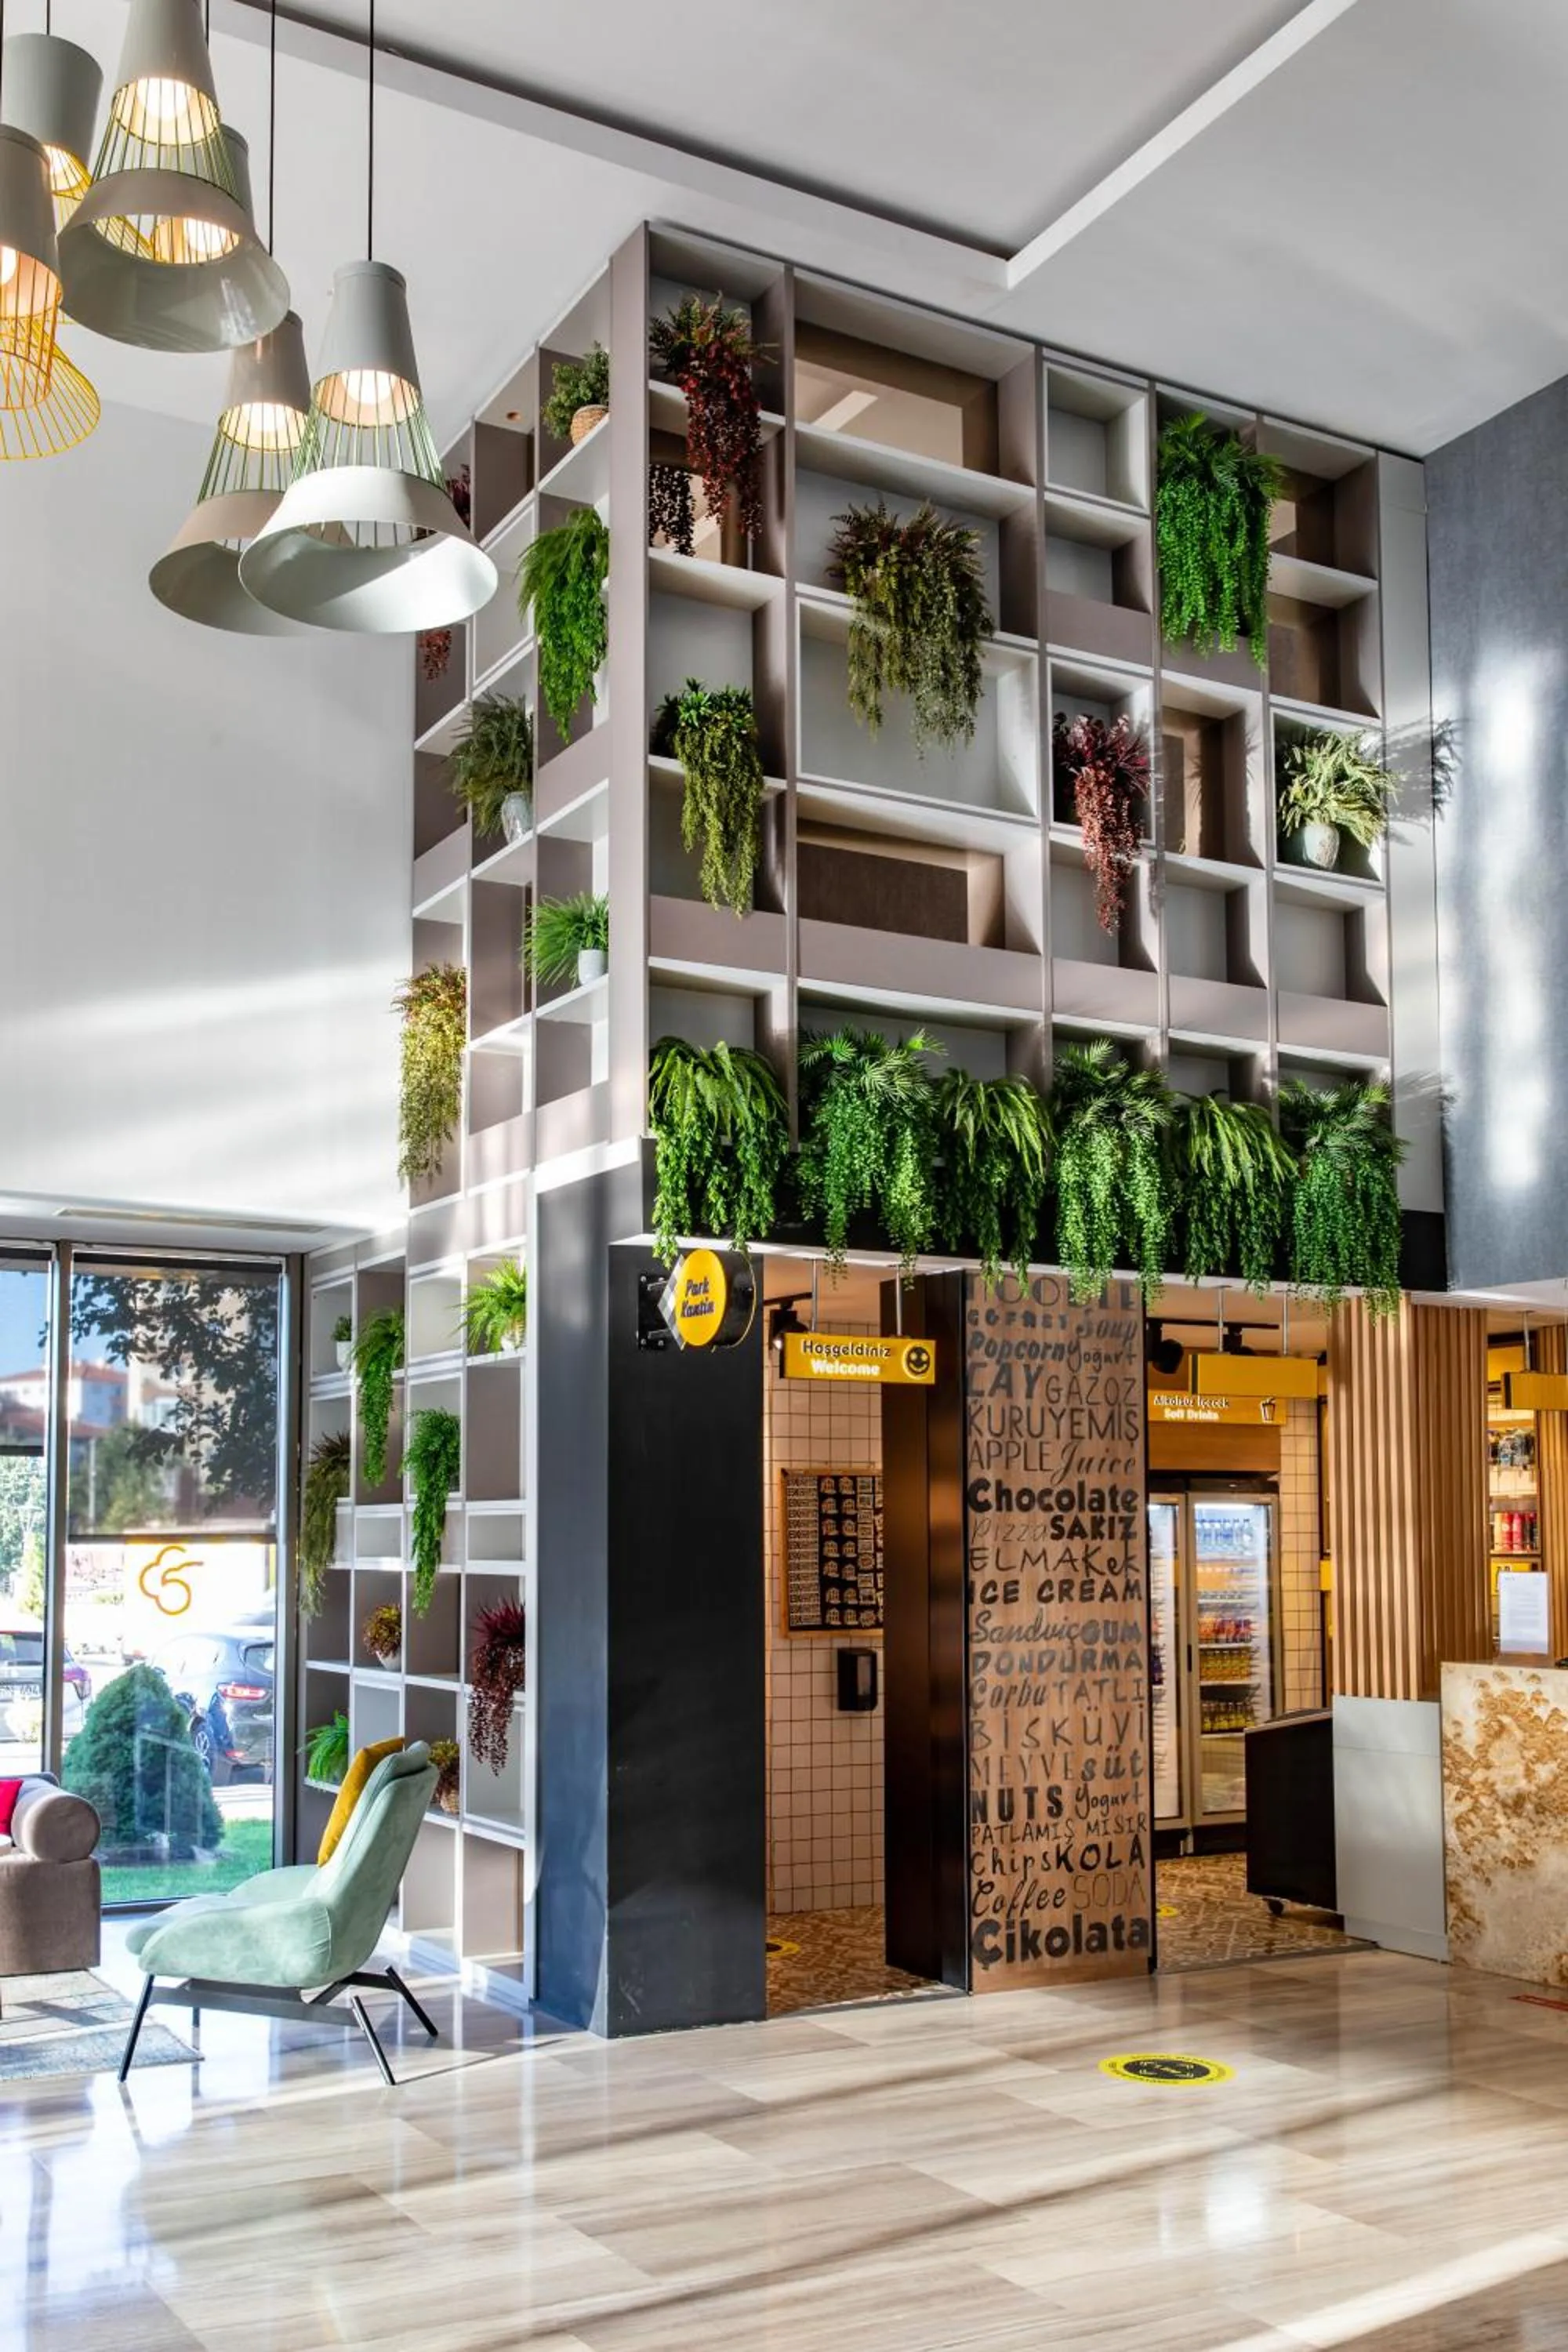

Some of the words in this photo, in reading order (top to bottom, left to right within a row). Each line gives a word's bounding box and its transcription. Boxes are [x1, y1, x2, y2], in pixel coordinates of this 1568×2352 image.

[685, 1276, 710, 1298] Park
[1076, 1308, 1137, 1346] Soup
[801, 1340, 891, 1358] Hoşgeldiniz
[967, 1330, 1067, 1367] Popcorn
[811, 1359, 880, 1376] Welcome
[1045, 1374, 1138, 1406] GAZOZ
[969, 1439, 1054, 1472] APPLE
[1051, 1439, 1137, 1486] Juice
[968, 1478, 1138, 1514] Chocolate
[1049, 1514, 1136, 1541] SAKIZ
[969, 1579, 1020, 1605] ICE
[1037, 1578, 1142, 1604] CREAM
[970, 1610, 1082, 1648] Sandviç
[971, 1647, 1144, 1676] DONDURMA
[1053, 1677, 1145, 1706] TATLI
[971, 1703, 1145, 1751] BİSKÜVİ
[971, 1750, 1076, 1786] MEYVE
[1080, 1744, 1145, 1781] süt
[971, 1784, 1064, 1824] NUTS
[1075, 1781, 1144, 1820] Yogurt
[971, 1817, 1076, 1844] PATLAMIŞ
[1086, 1812, 1147, 1838] MISIR
[971, 1846, 1051, 1882] Chips
[1055, 1834, 1145, 1873] KOLA
[971, 1878, 1066, 1918] Coffee
[1073, 1872, 1146, 1910] SODA
[971, 1913, 1150, 1970] Çikolata
